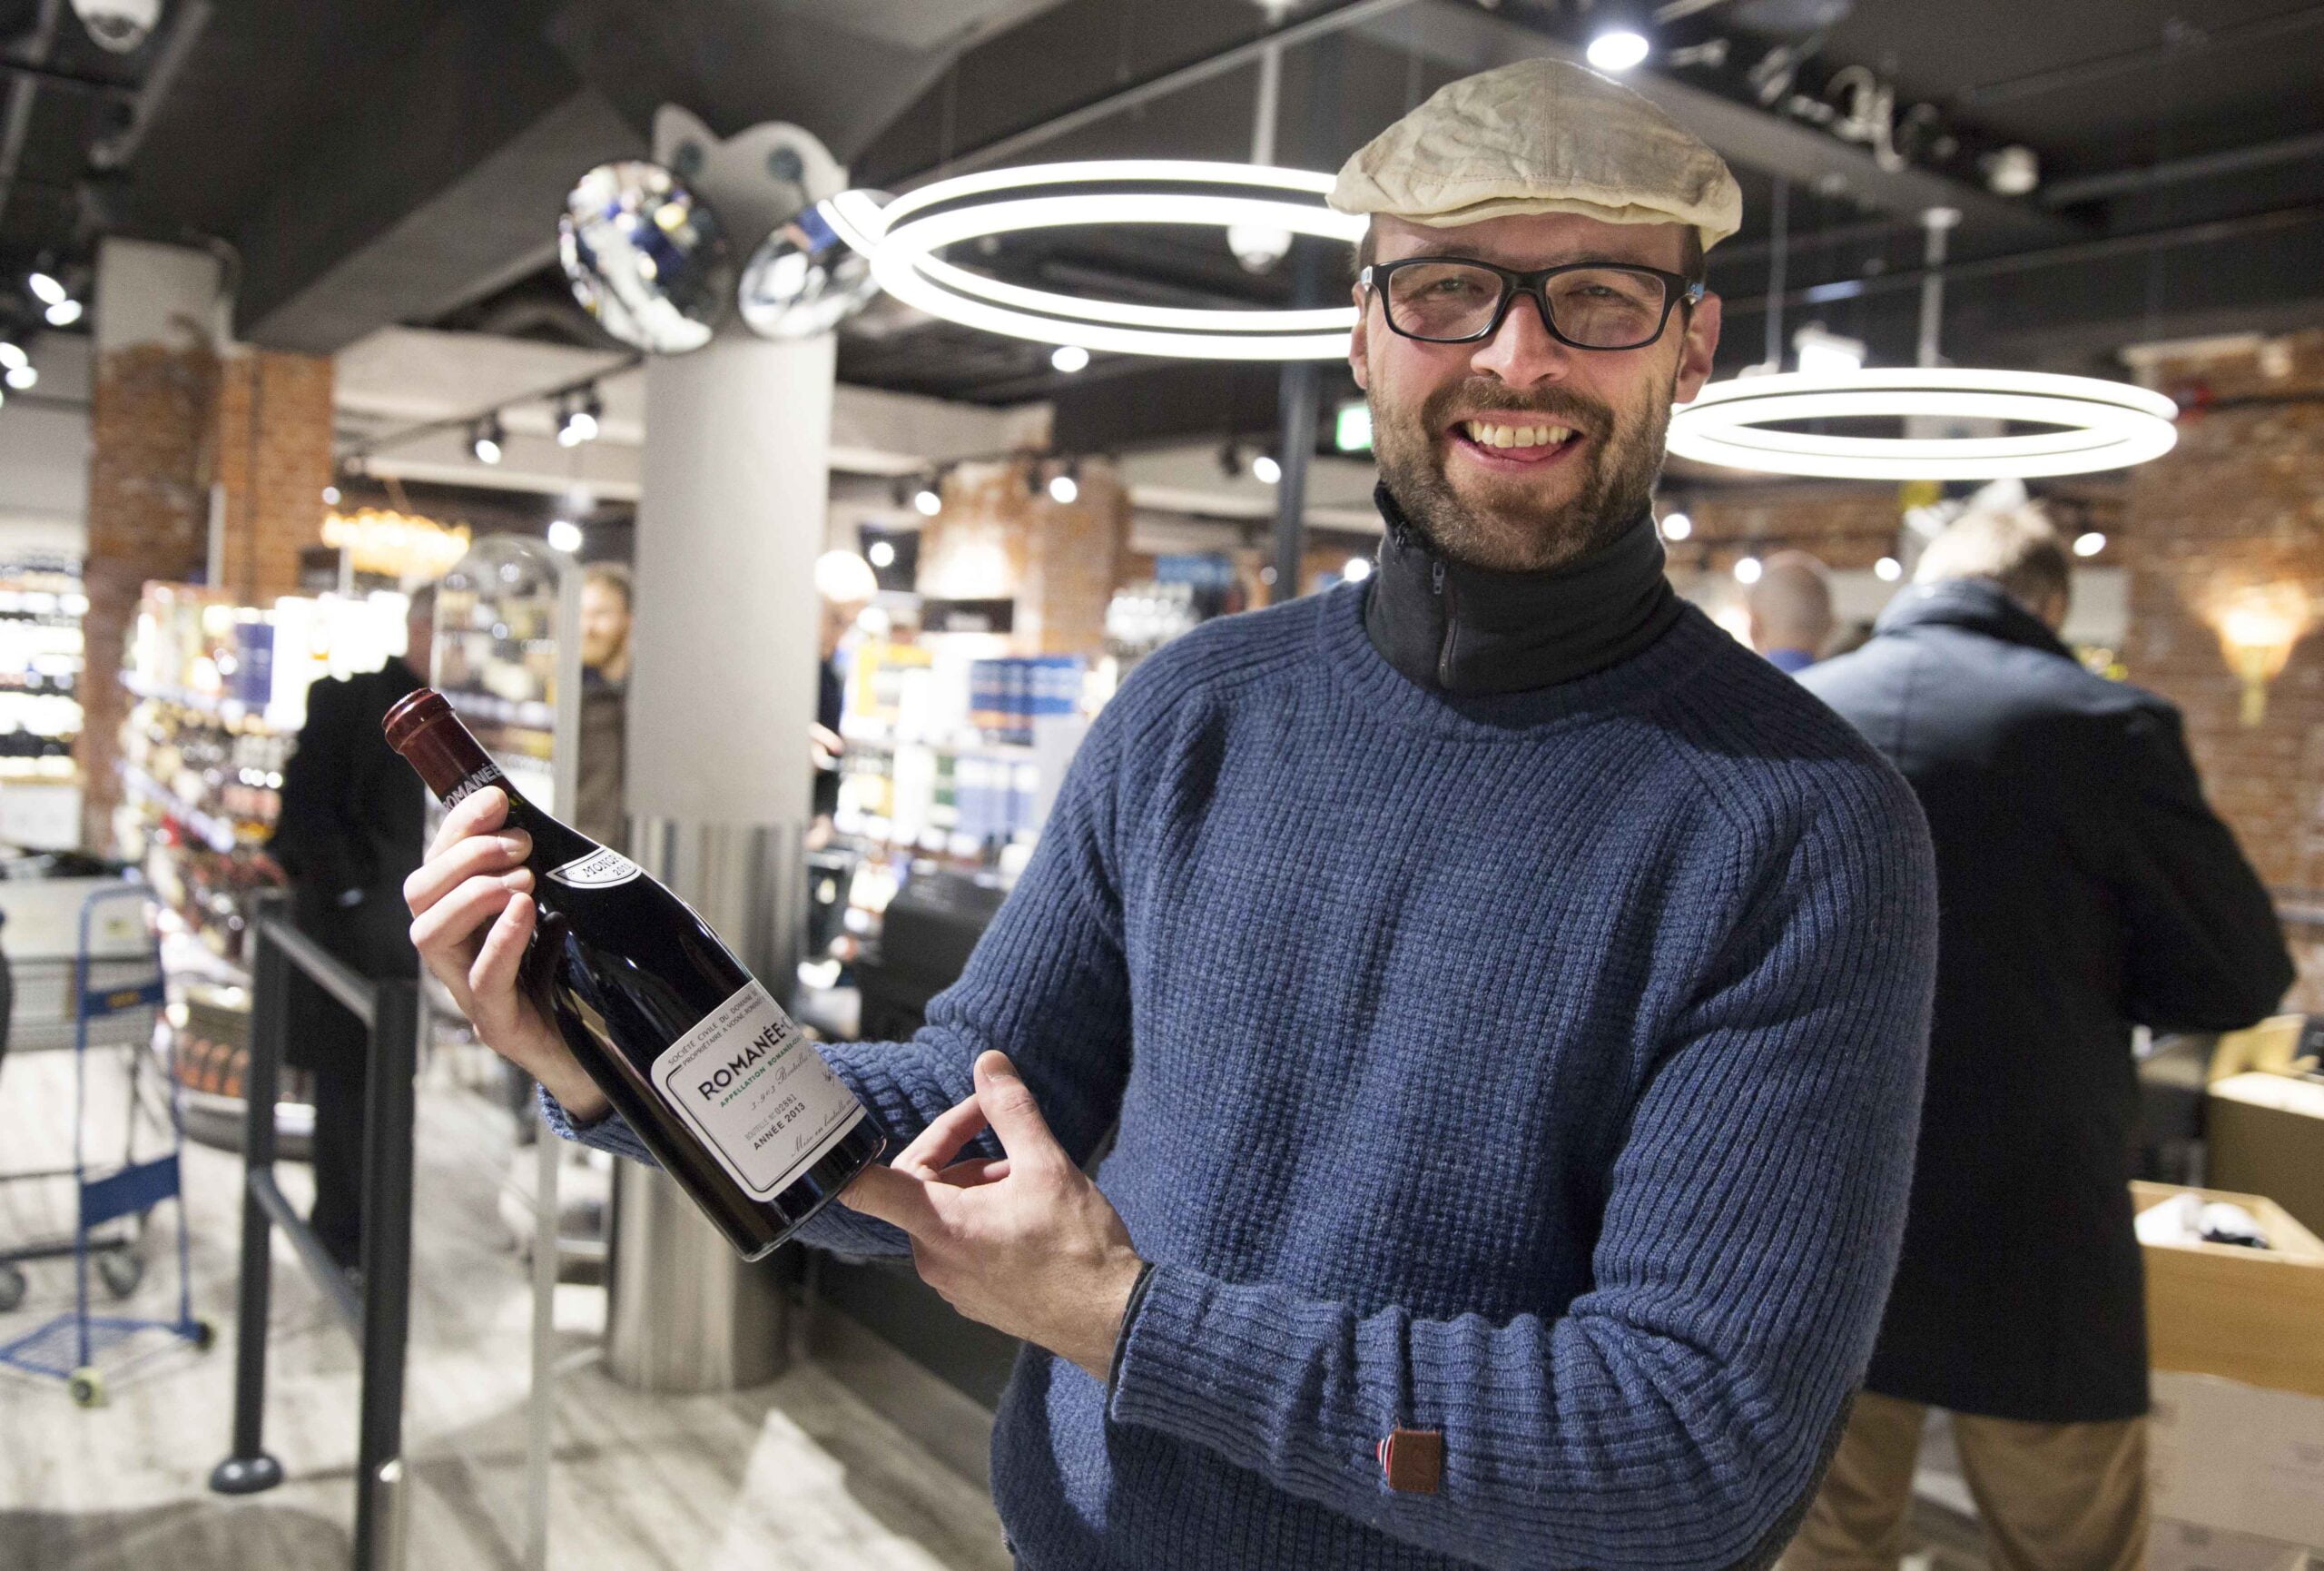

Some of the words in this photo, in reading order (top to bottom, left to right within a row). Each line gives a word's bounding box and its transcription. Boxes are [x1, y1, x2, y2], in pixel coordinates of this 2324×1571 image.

[697, 1023, 719, 1042] CIVILE
[718, 1013, 730, 1024] DU
[720, 1065, 767, 1108] APPELLATION
[753, 1120, 786, 1151] ANNÉE
[783, 1102, 806, 1123] 2013
